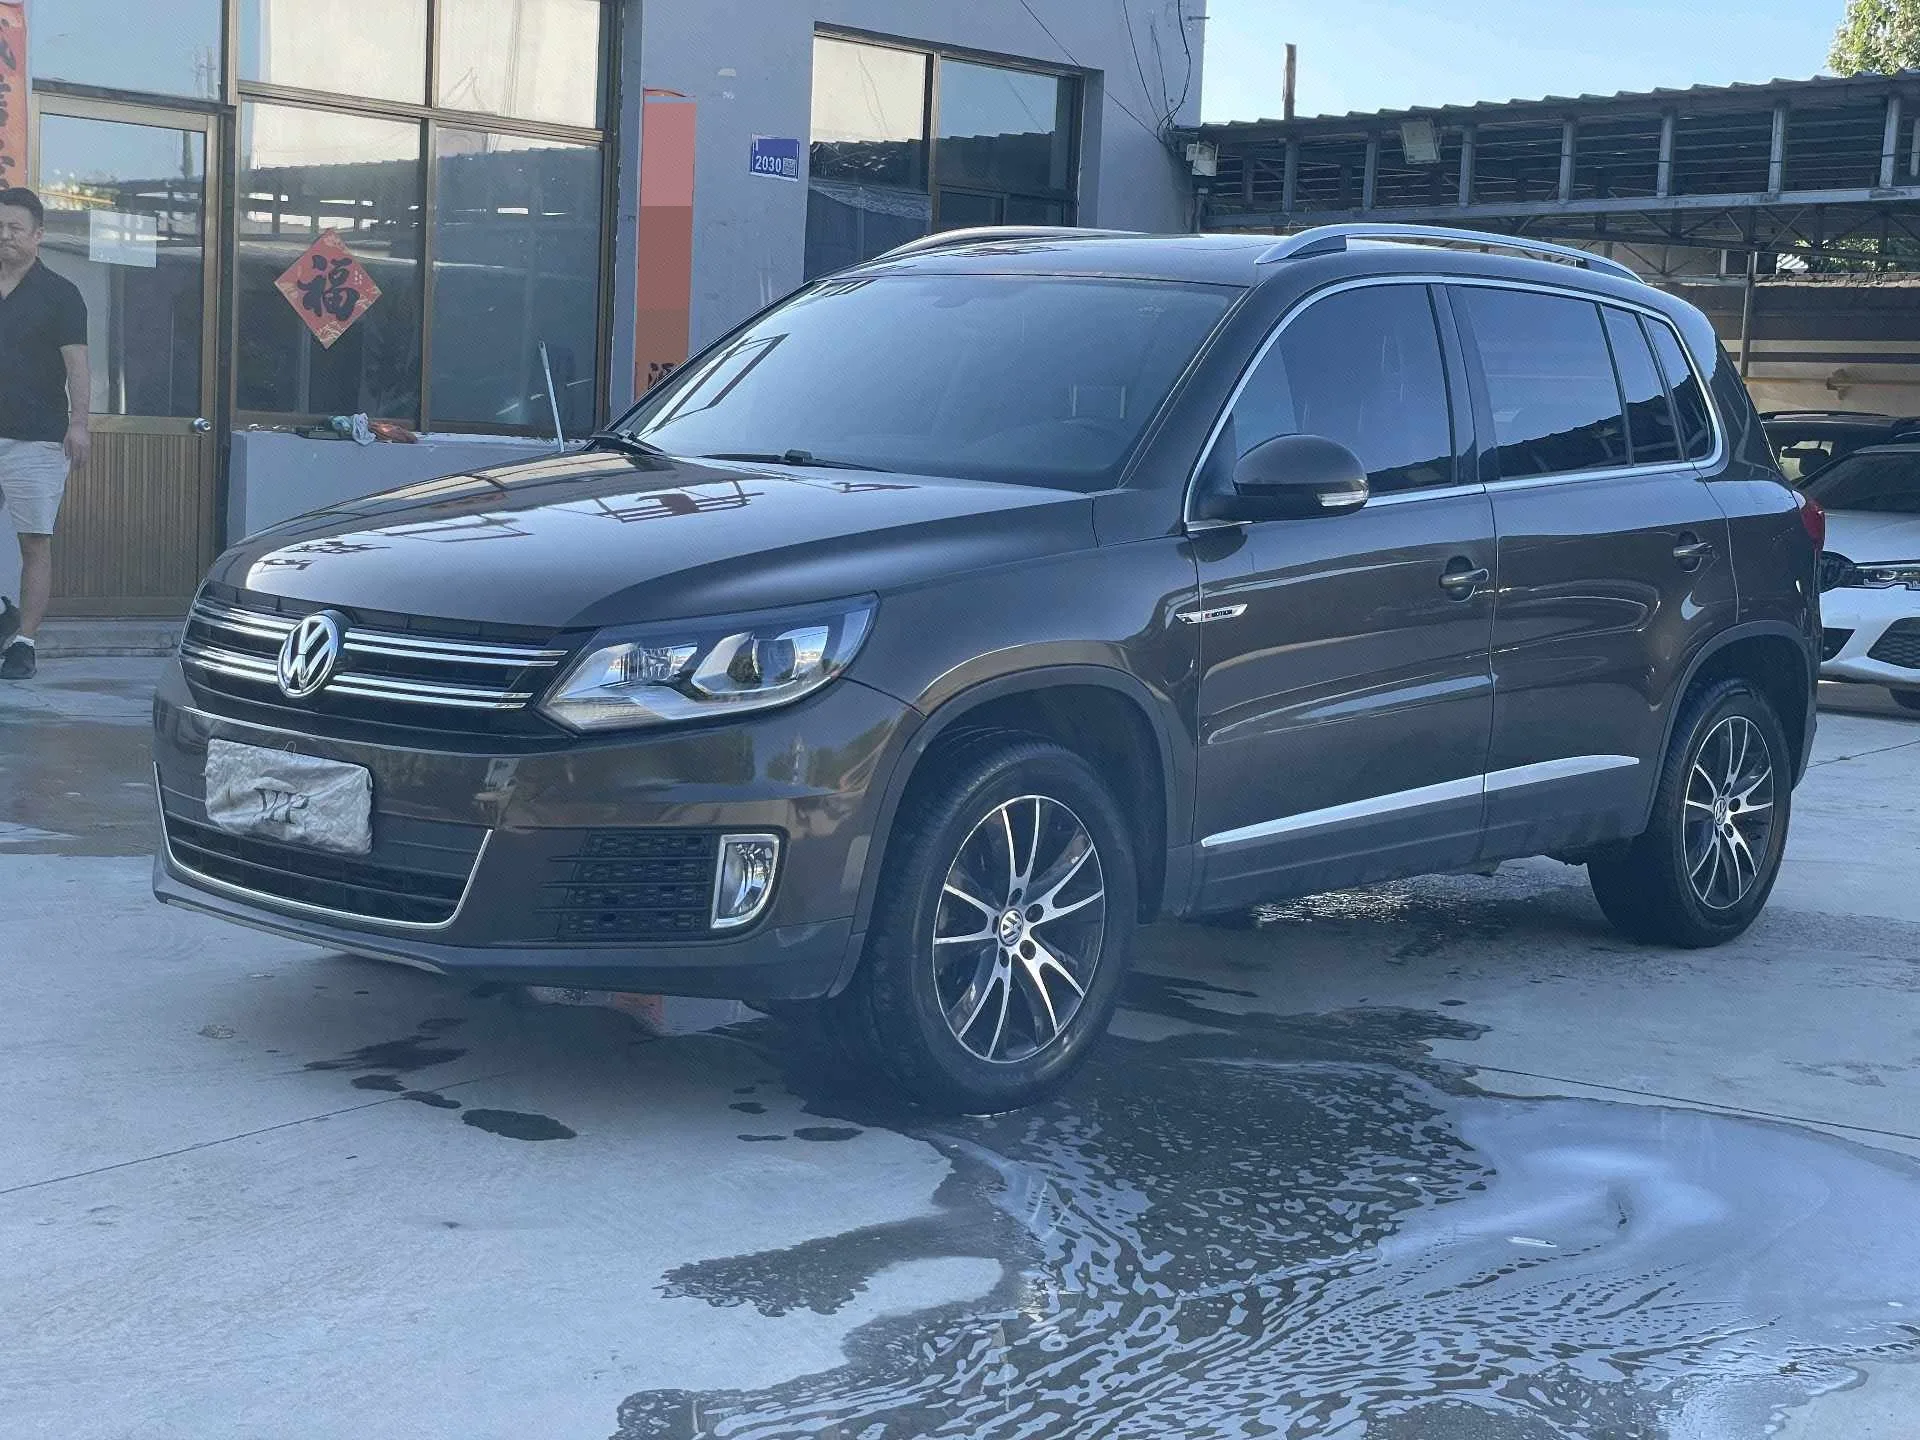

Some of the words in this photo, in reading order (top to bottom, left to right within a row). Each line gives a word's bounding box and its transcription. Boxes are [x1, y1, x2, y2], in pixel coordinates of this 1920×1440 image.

[755, 155, 781, 172] 2030
[297, 254, 360, 321] 福
[279, 612, 338, 696] VW
